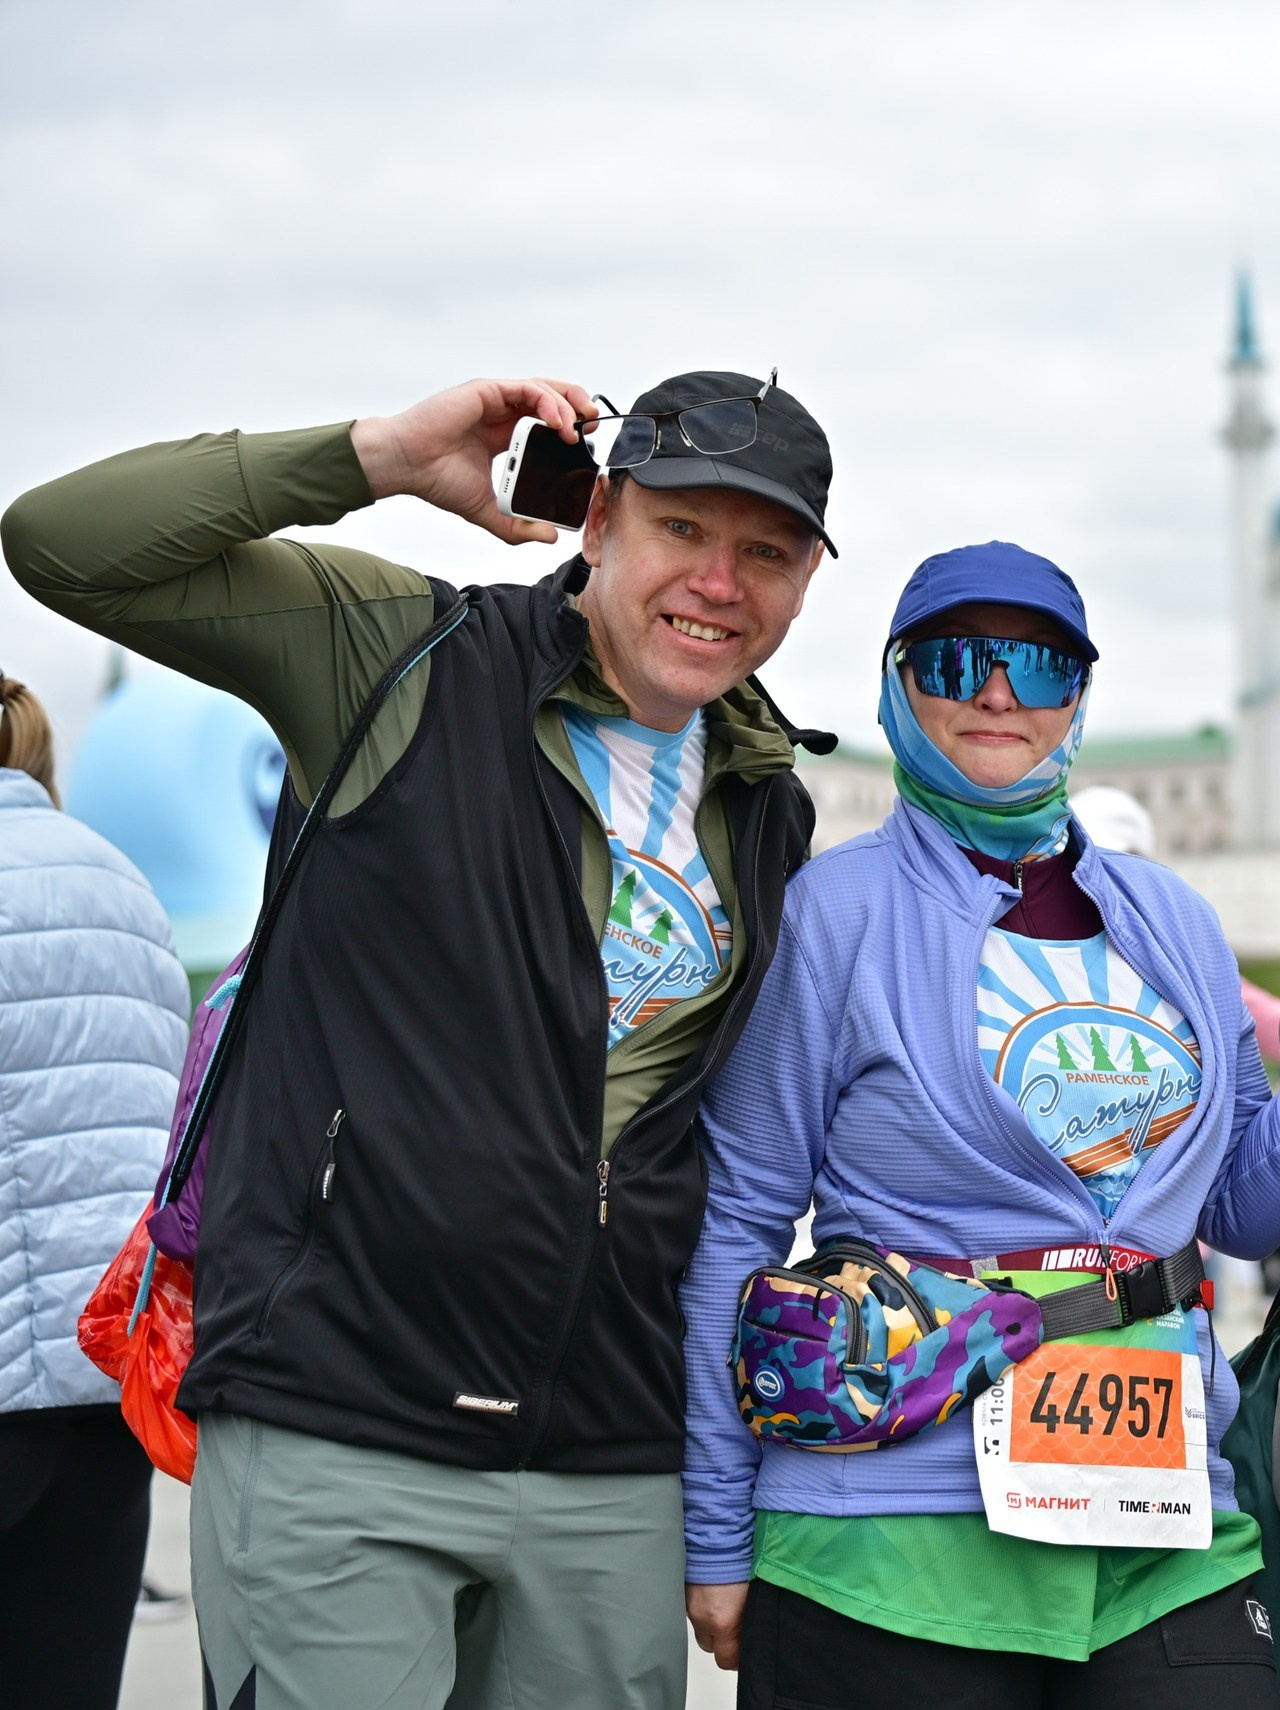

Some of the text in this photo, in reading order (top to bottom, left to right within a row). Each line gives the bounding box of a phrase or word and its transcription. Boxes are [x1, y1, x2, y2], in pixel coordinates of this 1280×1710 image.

[604, 922, 663, 959] ЕНСКОЕ
[1066, 1072, 1150, 1086] РАМЕНСКОЕ
[1030, 1371, 1174, 1439] 44957
[1025, 1496, 1091, 1510] МАГНИТ
